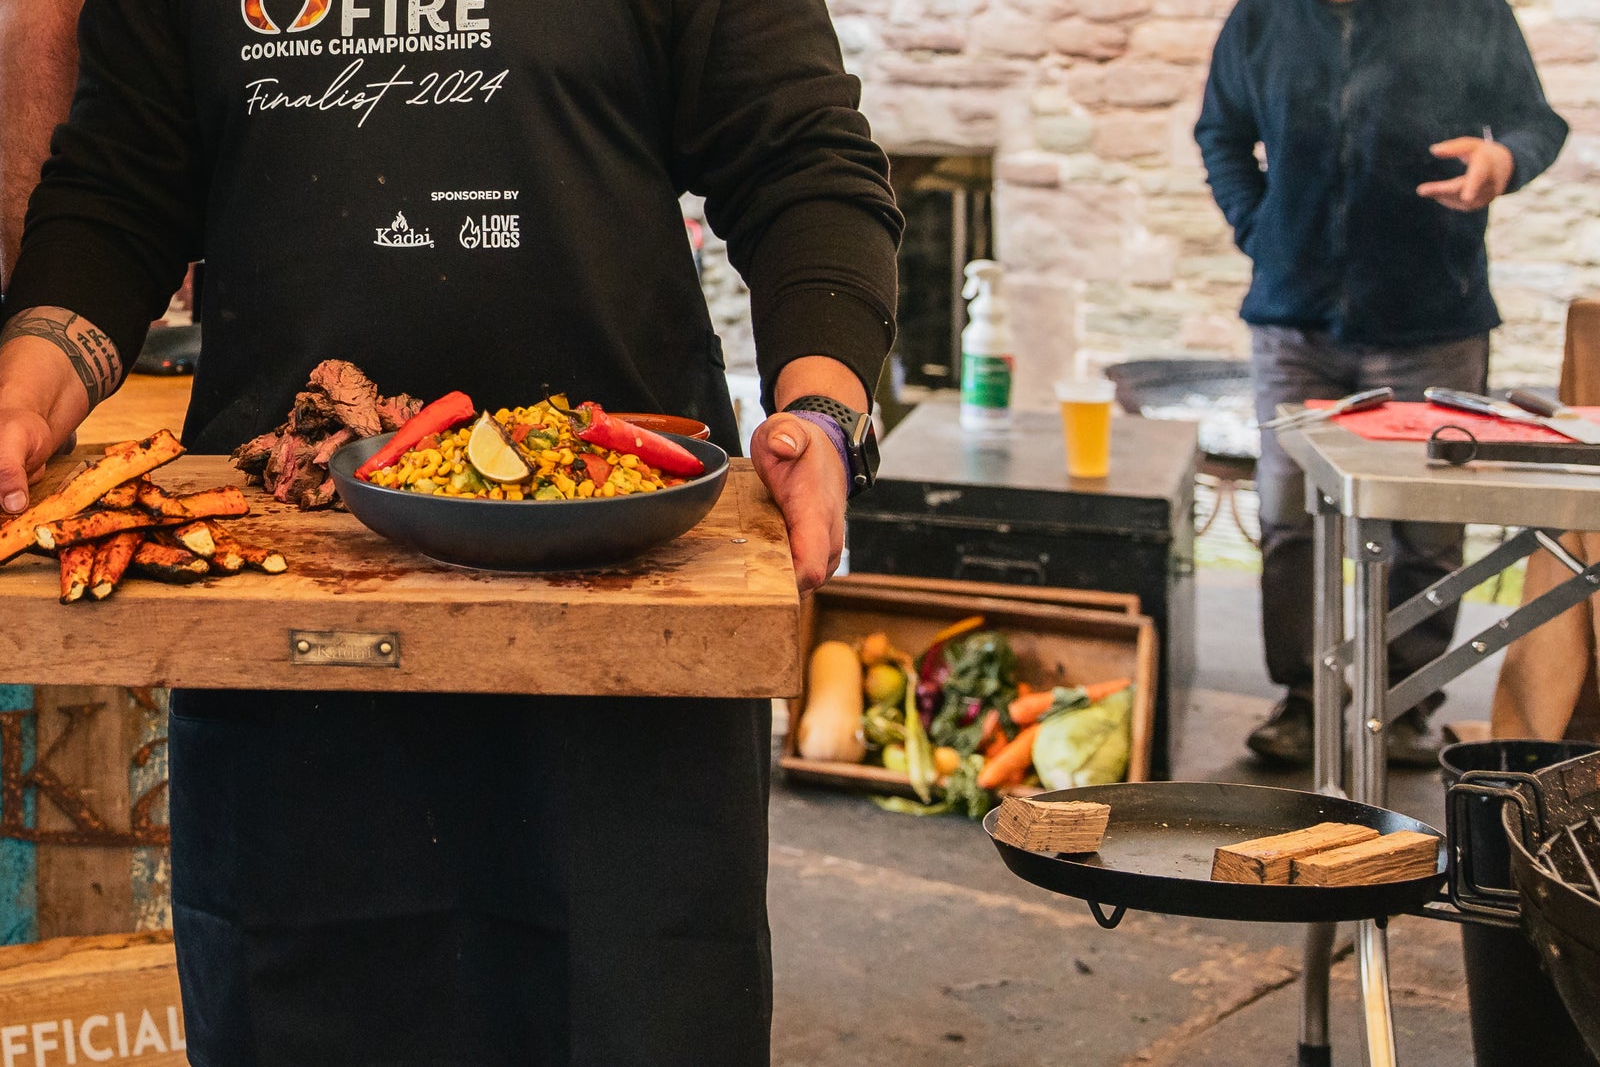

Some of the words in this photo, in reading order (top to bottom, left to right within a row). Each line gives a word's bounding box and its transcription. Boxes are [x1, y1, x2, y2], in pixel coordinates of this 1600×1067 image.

[241, 38, 323, 61] COOKING
[328, 32, 492, 55] CHAMPIONSHIPS
[246, 58, 413, 128] Finalist
[406, 69, 509, 105] 2024
[430, 190, 501, 201] SPONSORED
[503, 190, 519, 200] BY
[481, 214, 520, 232] LOVE
[375, 227, 430, 245] Kadai
[481, 231, 520, 249] LOGS
